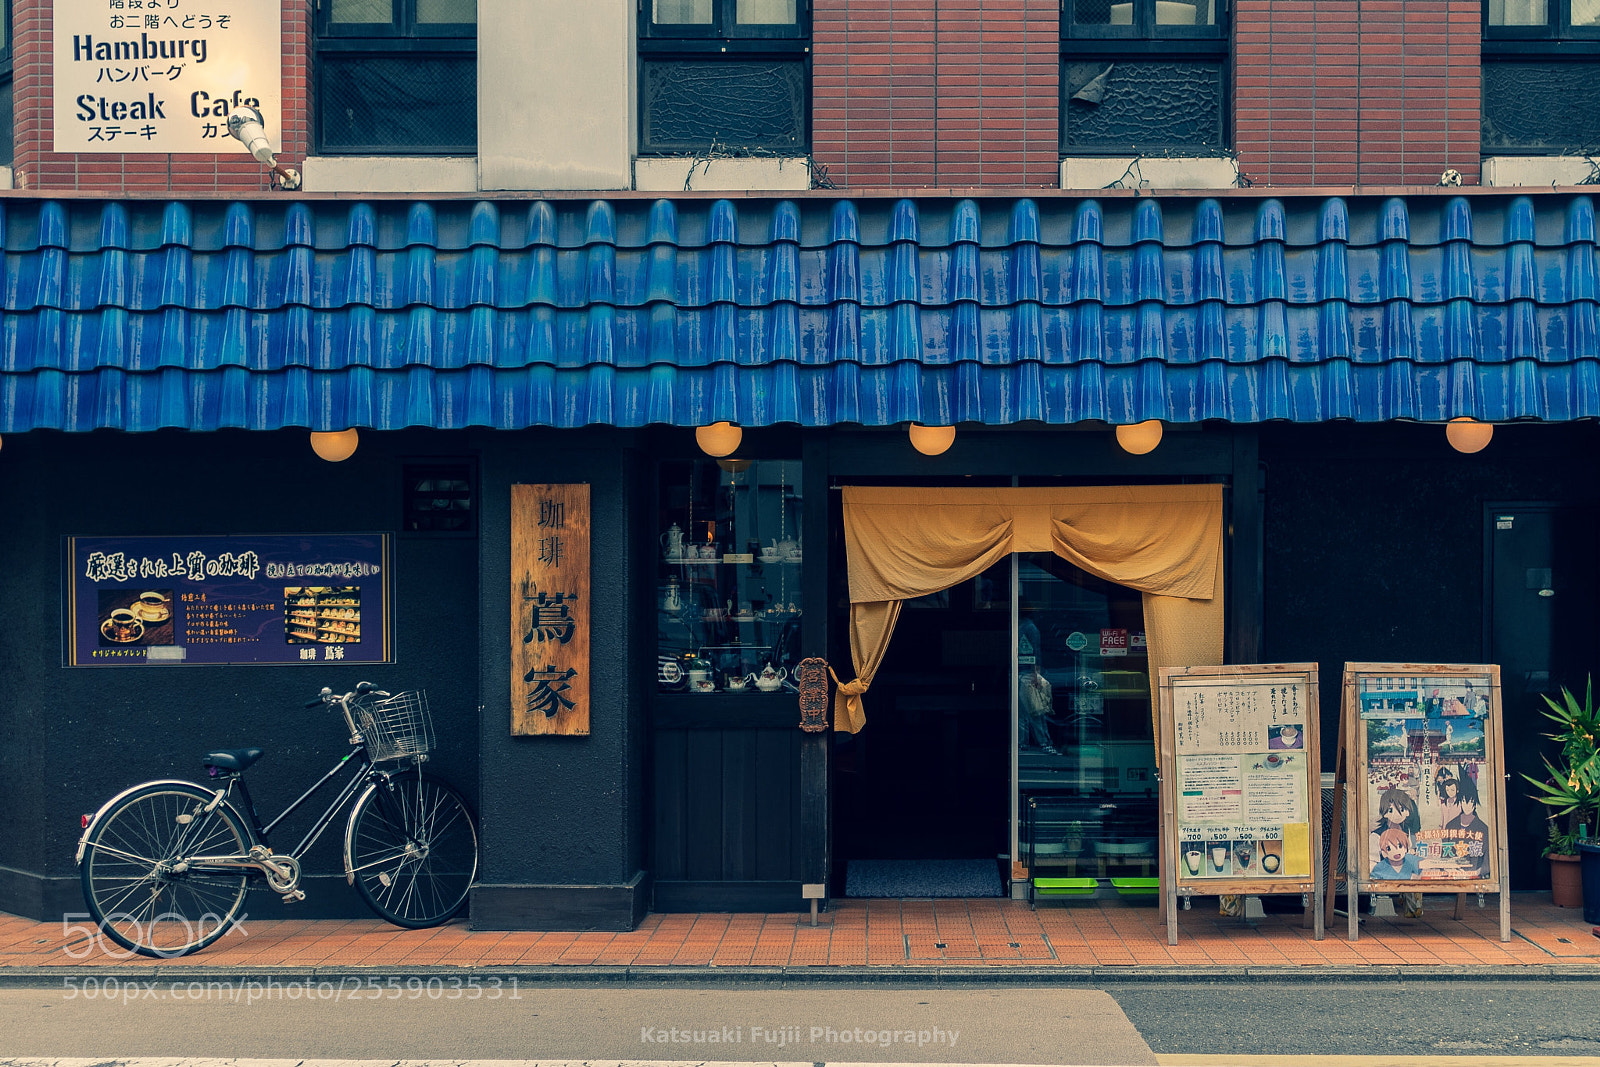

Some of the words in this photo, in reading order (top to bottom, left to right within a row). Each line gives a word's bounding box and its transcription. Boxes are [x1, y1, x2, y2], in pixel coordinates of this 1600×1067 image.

[110, 14, 232, 29] お二階へどうぞ
[73, 33, 208, 63] Hamburg
[96, 63, 187, 83] ハンバーグ
[76, 93, 166, 122] Steak
[87, 125, 157, 142] ステーキ
[537, 501, 565, 568] 珈琲
[86, 551, 260, 582] 厳選された上質の珈琲
[1102, 637, 1125, 645] FREE
[523, 592, 579, 720] 蔦家
[1416, 841, 1484, 858] 有頂天家族
